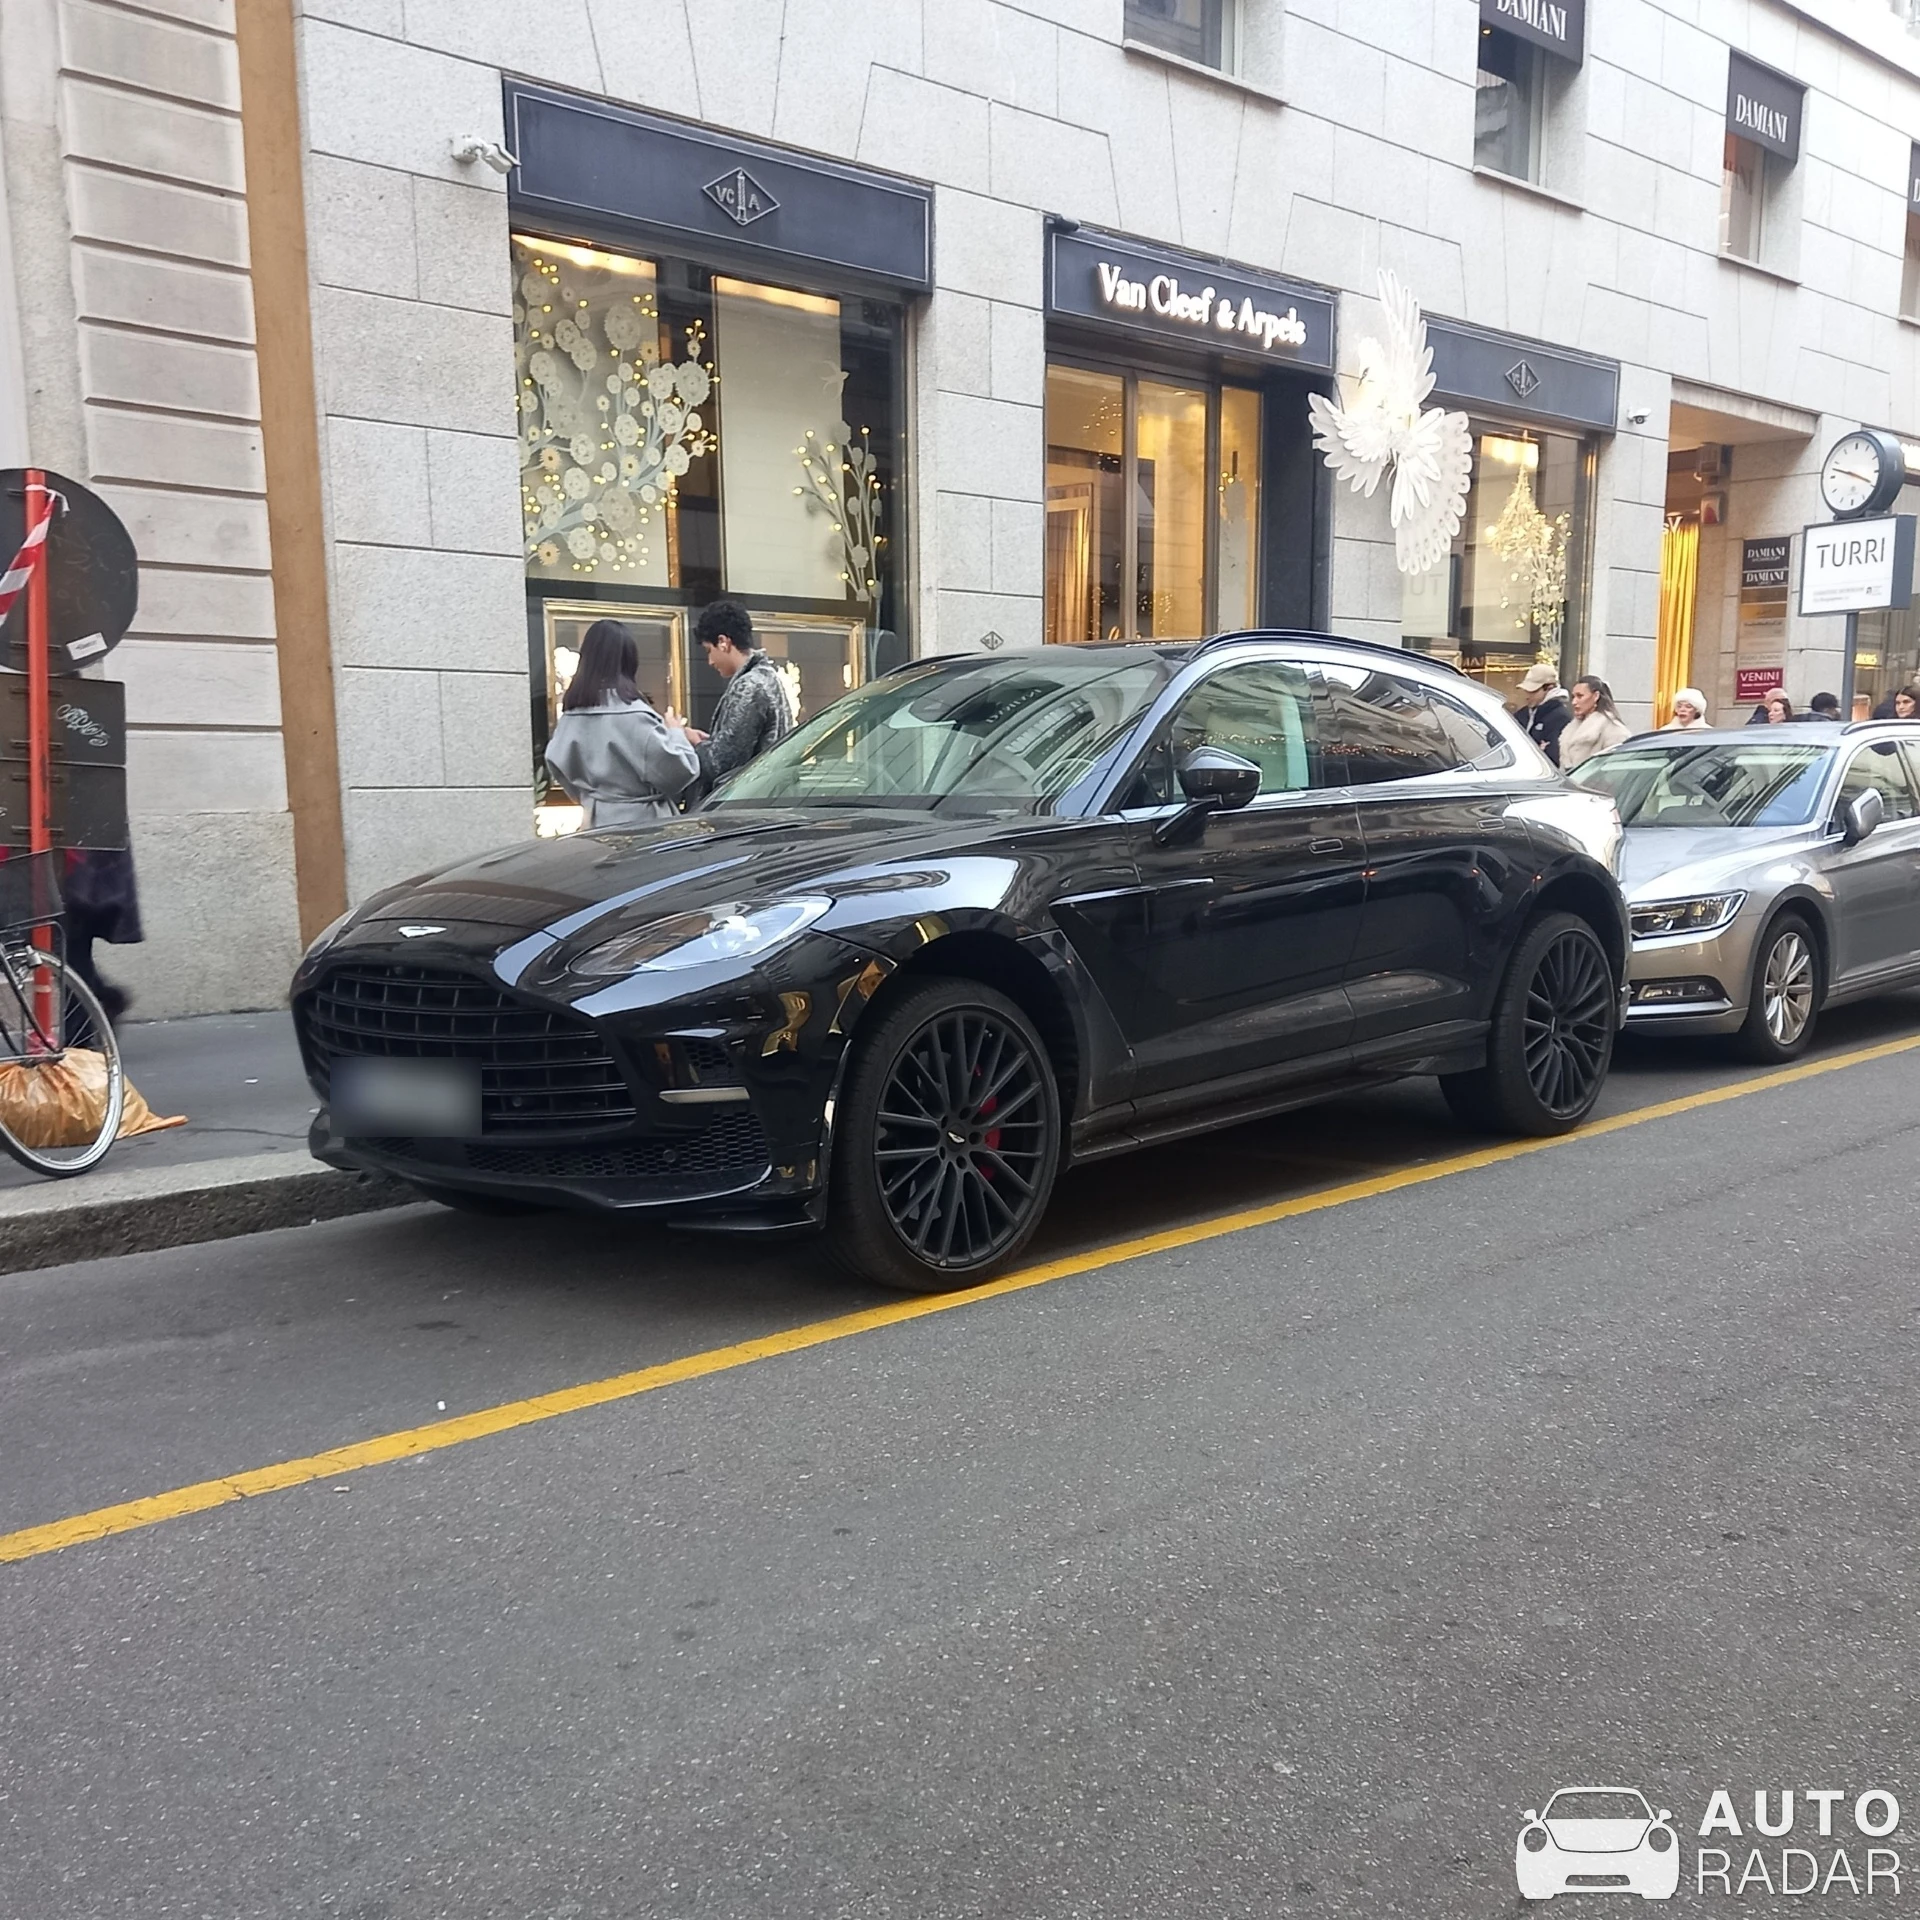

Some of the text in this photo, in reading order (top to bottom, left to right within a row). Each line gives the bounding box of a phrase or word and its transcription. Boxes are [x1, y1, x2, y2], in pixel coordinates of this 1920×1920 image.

[1735, 93, 1788, 143] DAMIANI
[1097, 262, 1307, 349] Van Cleef & Arpels
[1747, 546, 1786, 559] DAMIANI
[1816, 537, 1886, 569] TURRI
[1746, 571, 1784, 583] DAMIANI
[1740, 671, 1780, 682] VENINI
